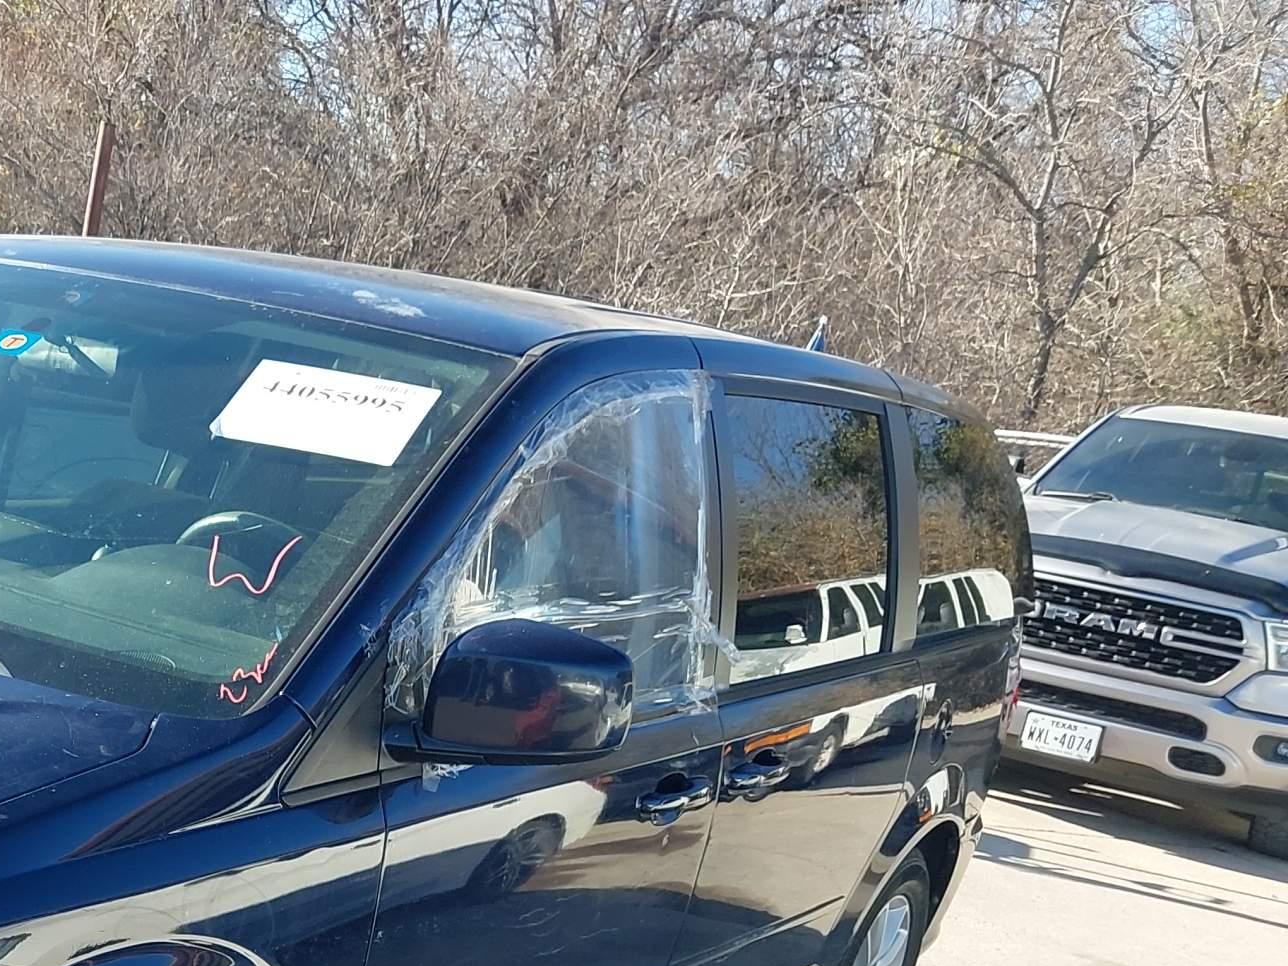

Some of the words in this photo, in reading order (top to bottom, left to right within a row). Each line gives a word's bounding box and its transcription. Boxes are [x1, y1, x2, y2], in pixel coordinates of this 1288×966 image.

[263, 380, 405, 413] 44055995
[1043, 602, 1159, 640] RAM
[1050, 720, 1078, 732] TEXAS
